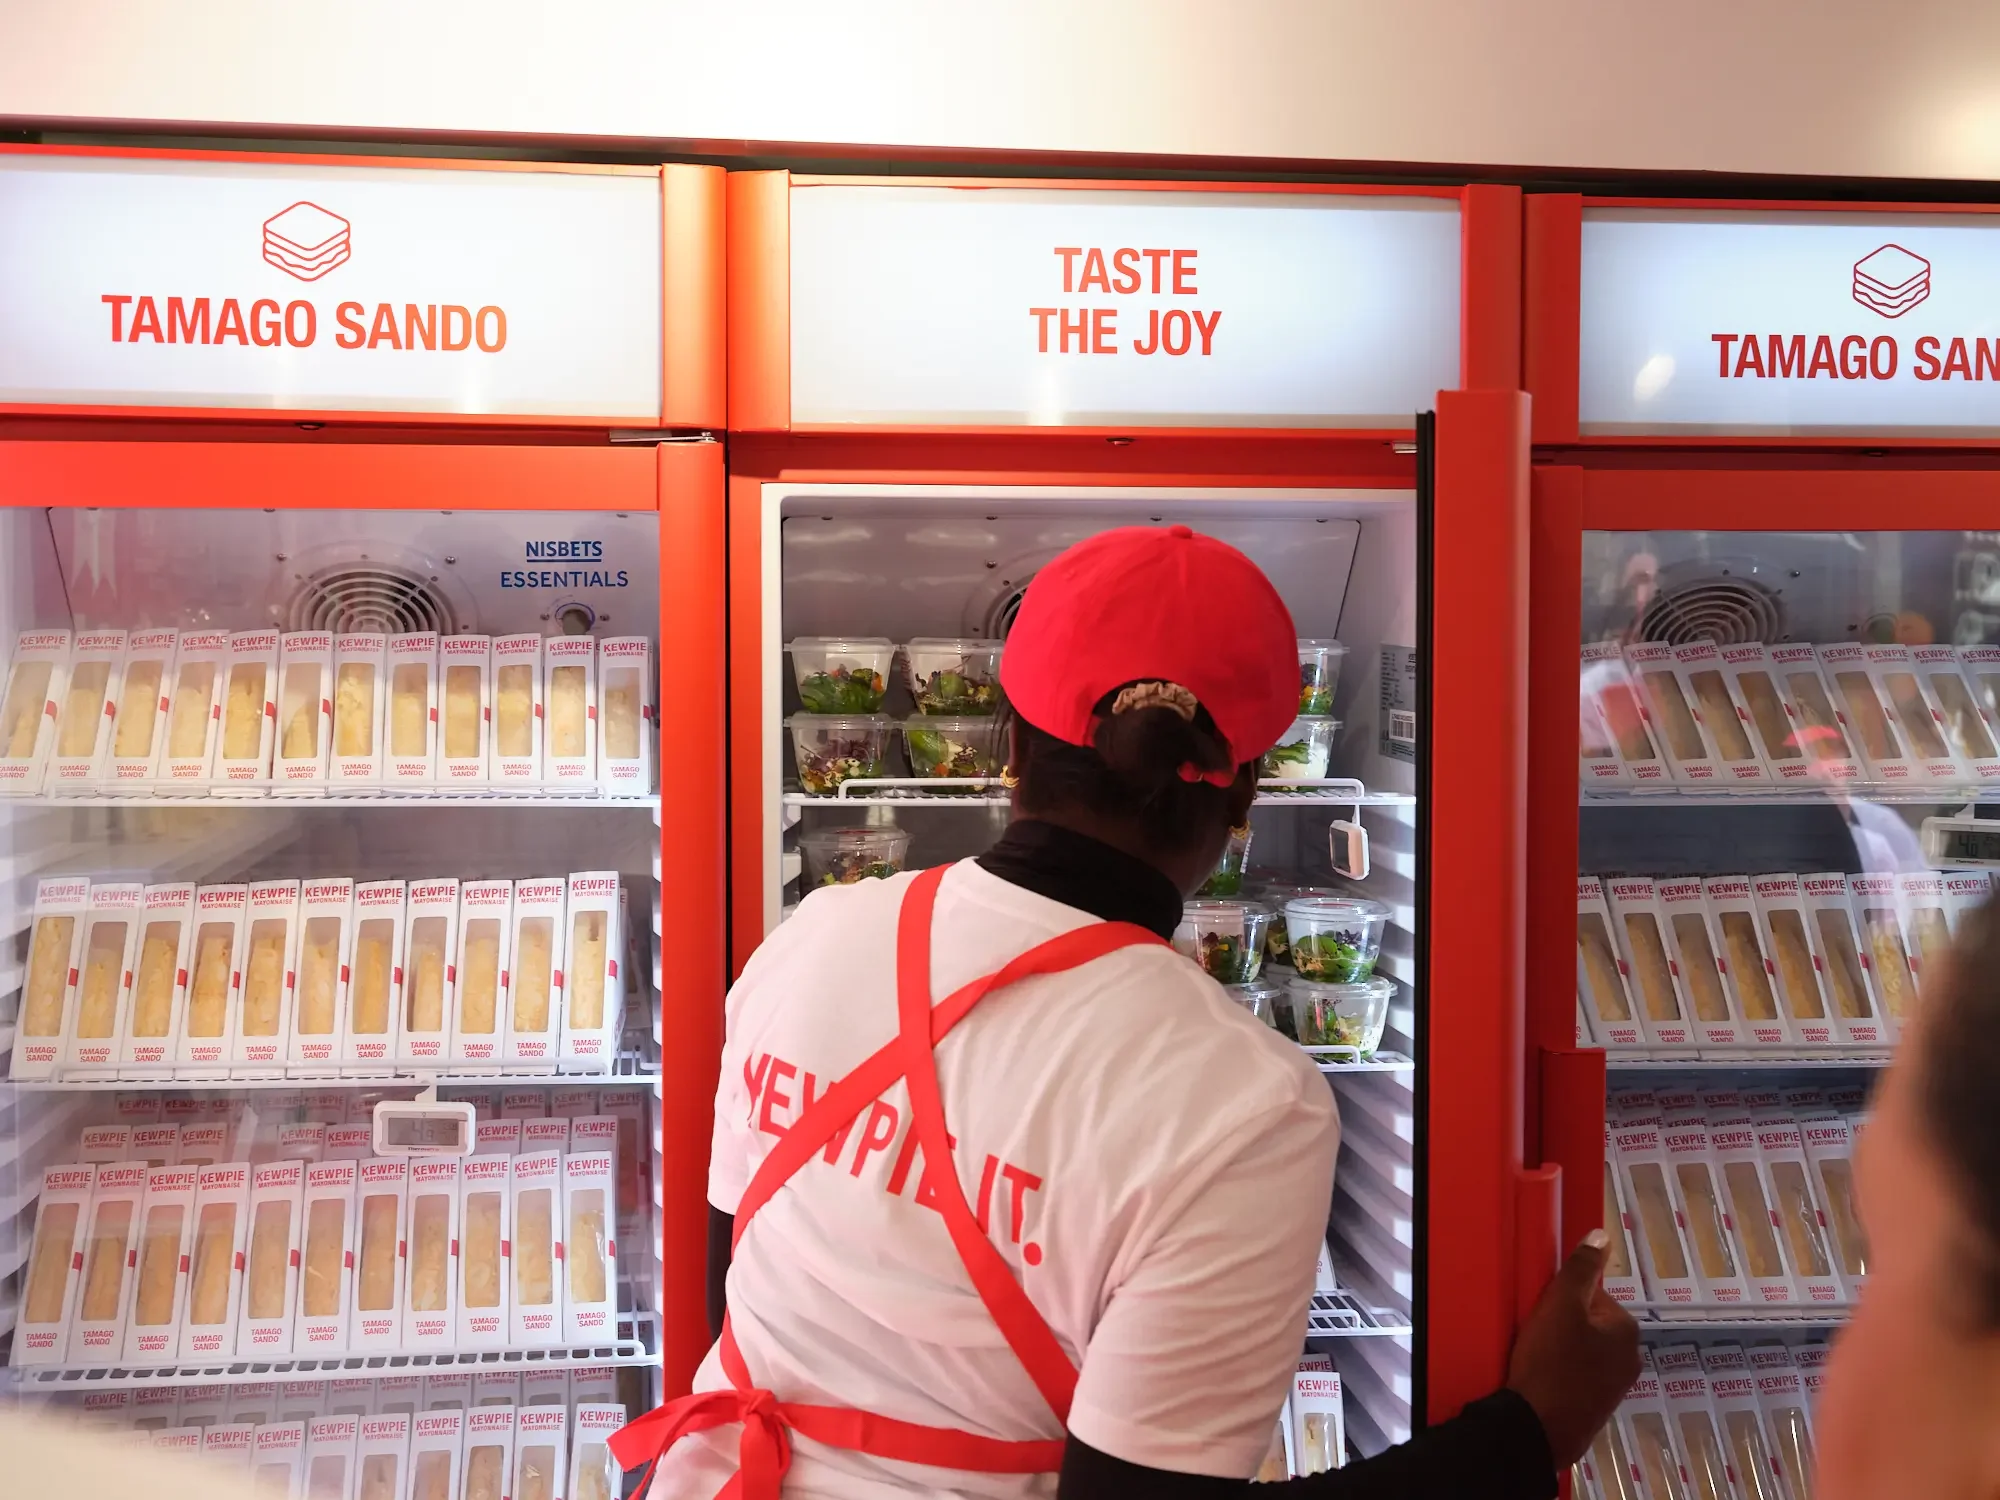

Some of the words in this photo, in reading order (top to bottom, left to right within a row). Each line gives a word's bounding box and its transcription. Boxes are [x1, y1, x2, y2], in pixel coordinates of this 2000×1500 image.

[1054, 247, 1197, 294] TASTE
[101, 295, 317, 348] TAMAGO
[335, 301, 507, 353] SANDO
[1029, 307, 1117, 354] THE
[1133, 309, 1222, 356] JOY
[1711, 334, 1898, 380] TAMAGO
[526, 541, 603, 557] NISBETS
[501, 571, 629, 587] ESSENTIALS
[20, 635, 66, 646] KEWPIE
[77, 636, 124, 646] KEWPIE
[131, 634, 175, 646] KEWPIE
[231, 636, 277, 648] KEWPIE
[285, 636, 330, 647] KEWPIE
[339, 638, 383, 649] KEWPIE
[391, 637, 435, 648] KEWPIE
[444, 640, 489, 650] KEWPIE
[496, 638, 539, 650] KEWPIE
[550, 641, 593, 651] KEWPIE
[604, 642, 647, 652] KEWPIE
[1675, 645, 1717, 659] KEWPIE
[1721, 648, 1764, 661] KEWPIE
[1821, 648, 1864, 659] KEWPIE
[572, 879, 616, 890] KEWPIE
[1612, 884, 1654, 895] KEWPIE
[1660, 884, 1701, 896] KEWPIE
[1708, 883, 1750, 894] KEWPIE
[1803, 880, 1846, 890] KEWPIE
[1852, 879, 1894, 890] KEWPIE
[1947, 879, 1990, 890] KEWPIE
[40, 885, 86, 897] KEWPIE
[93, 890, 139, 902] KEWPIE
[145, 890, 190, 902] KEWPIE
[251, 888, 297, 899] KEWPIE
[305, 886, 350, 897] KEWPIE
[358, 888, 403, 899] KEWPIE
[411, 886, 456, 898] KEWPIE
[465, 888, 509, 899] KEWPIE
[518, 886, 562, 897] KEWPIE
[200, 891, 245, 903] KEWPIE
[521, 896, 559, 904] MAYONNAISE
[355, 1043, 387, 1051] TAMAGO
[410, 1041, 441, 1049] TAMAGO
[463, 1043, 494, 1051] TAMAGO
[516, 1042, 547, 1050] TAMAGO
[572, 1039, 602, 1047] TAMAGO
[25, 1046, 57, 1054] TAMAGO
[133, 1047, 164, 1055] TAMAGO
[27, 1054, 53, 1062] SANDO
[135, 1054, 161, 1062] SANDO
[477, 1125, 519, 1137] KEWPIE
[526, 1124, 567, 1135] KEWPIE
[575, 1121, 616, 1133] KEWPIE
[133, 1129, 177, 1141] KEWPIE
[328, 1130, 370, 1141] KEWPIE
[1616, 1132, 1659, 1146] KEWPIE
[1712, 1131, 1753, 1145] KEWPIE
[1758, 1131, 1800, 1145] KEWPIE
[1806, 1128, 1848, 1140] KEWPIE
[1665, 1133, 1706, 1147] KEWPIE
[361, 1163, 406, 1175] KEWPIE
[413, 1163, 457, 1175] KEWPIE
[464, 1161, 508, 1173] KEWPIE
[514, 1158, 558, 1172] KEWPIE
[566, 1159, 610, 1171] KEWPIE
[45, 1171, 92, 1184] KEWPIE
[99, 1169, 144, 1181] KEWPIE
[149, 1173, 195, 1185] KEWPIE
[200, 1171, 245, 1183] KEWPIE
[255, 1168, 300, 1181] KEWPIE
[309, 1167, 354, 1180] KEWPIE
[415, 1174, 454, 1182] MAYONNAISE
[467, 1172, 505, 1180] MAYONNAISE
[977, 1154, 1043, 1266] IT.
[469, 1317, 500, 1325] TAMAGO
[522, 1314, 553, 1322] TAMAGO
[578, 1319, 604, 1327] SANDO
[362, 1320, 393, 1328] TAMAGO
[415, 1320, 446, 1328] TAMAGO
[471, 1324, 497, 1332] SANDO
[26, 1332, 58, 1340] TAMAGO
[83, 1330, 114, 1338] TAMAGO
[251, 1328, 282, 1336] TAMAGO
[364, 1327, 389, 1335] SANDO
[418, 1327, 443, 1335] SANDO
[27, 1340, 53, 1348] SANDO
[84, 1337, 110, 1345] SANDO
[137, 1335, 169, 1343] TAMAGO
[252, 1335, 279, 1343] SANDO
[139, 1342, 165, 1350] SANDO
[193, 1342, 220, 1350] SANDO
[1705, 1352, 1744, 1366] KEWPIE
[1297, 1380, 1340, 1391] KEWPIE
[1664, 1378, 1706, 1393] KEWPIE
[1712, 1378, 1753, 1392] KEWPIE
[1757, 1375, 1799, 1389] KEWPIE
[469, 1412, 513, 1425] KEWPIE
[520, 1413, 564, 1425] KEWPIE
[579, 1411, 623, 1423] KEWPIE
[363, 1421, 407, 1434] KEWPIE
[416, 1417, 460, 1430] KEWPIE
[206, 1431, 252, 1444] KEWPIE
[257, 1429, 301, 1443] KEWPIE
